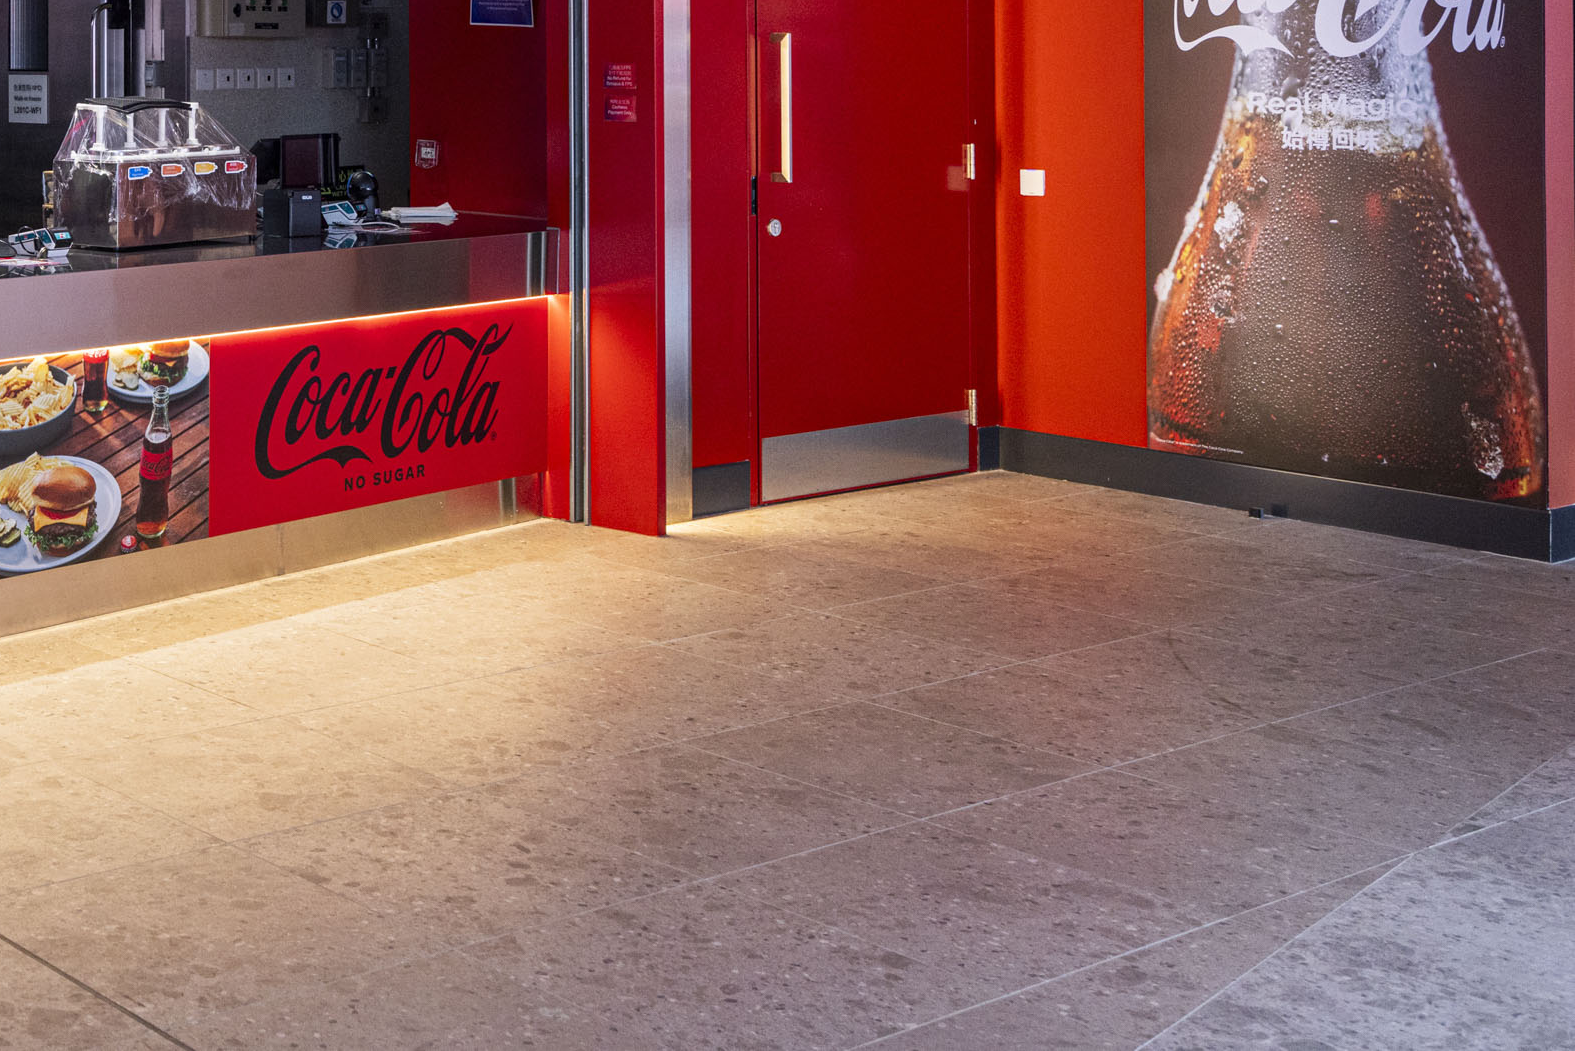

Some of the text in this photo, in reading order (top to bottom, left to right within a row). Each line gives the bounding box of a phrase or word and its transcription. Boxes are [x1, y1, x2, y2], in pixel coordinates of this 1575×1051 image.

[1246, 92, 1418, 122] Real Magic
[254, 323, 513, 479] Coca-Cola
[344, 464, 425, 491] NO SUGAR
